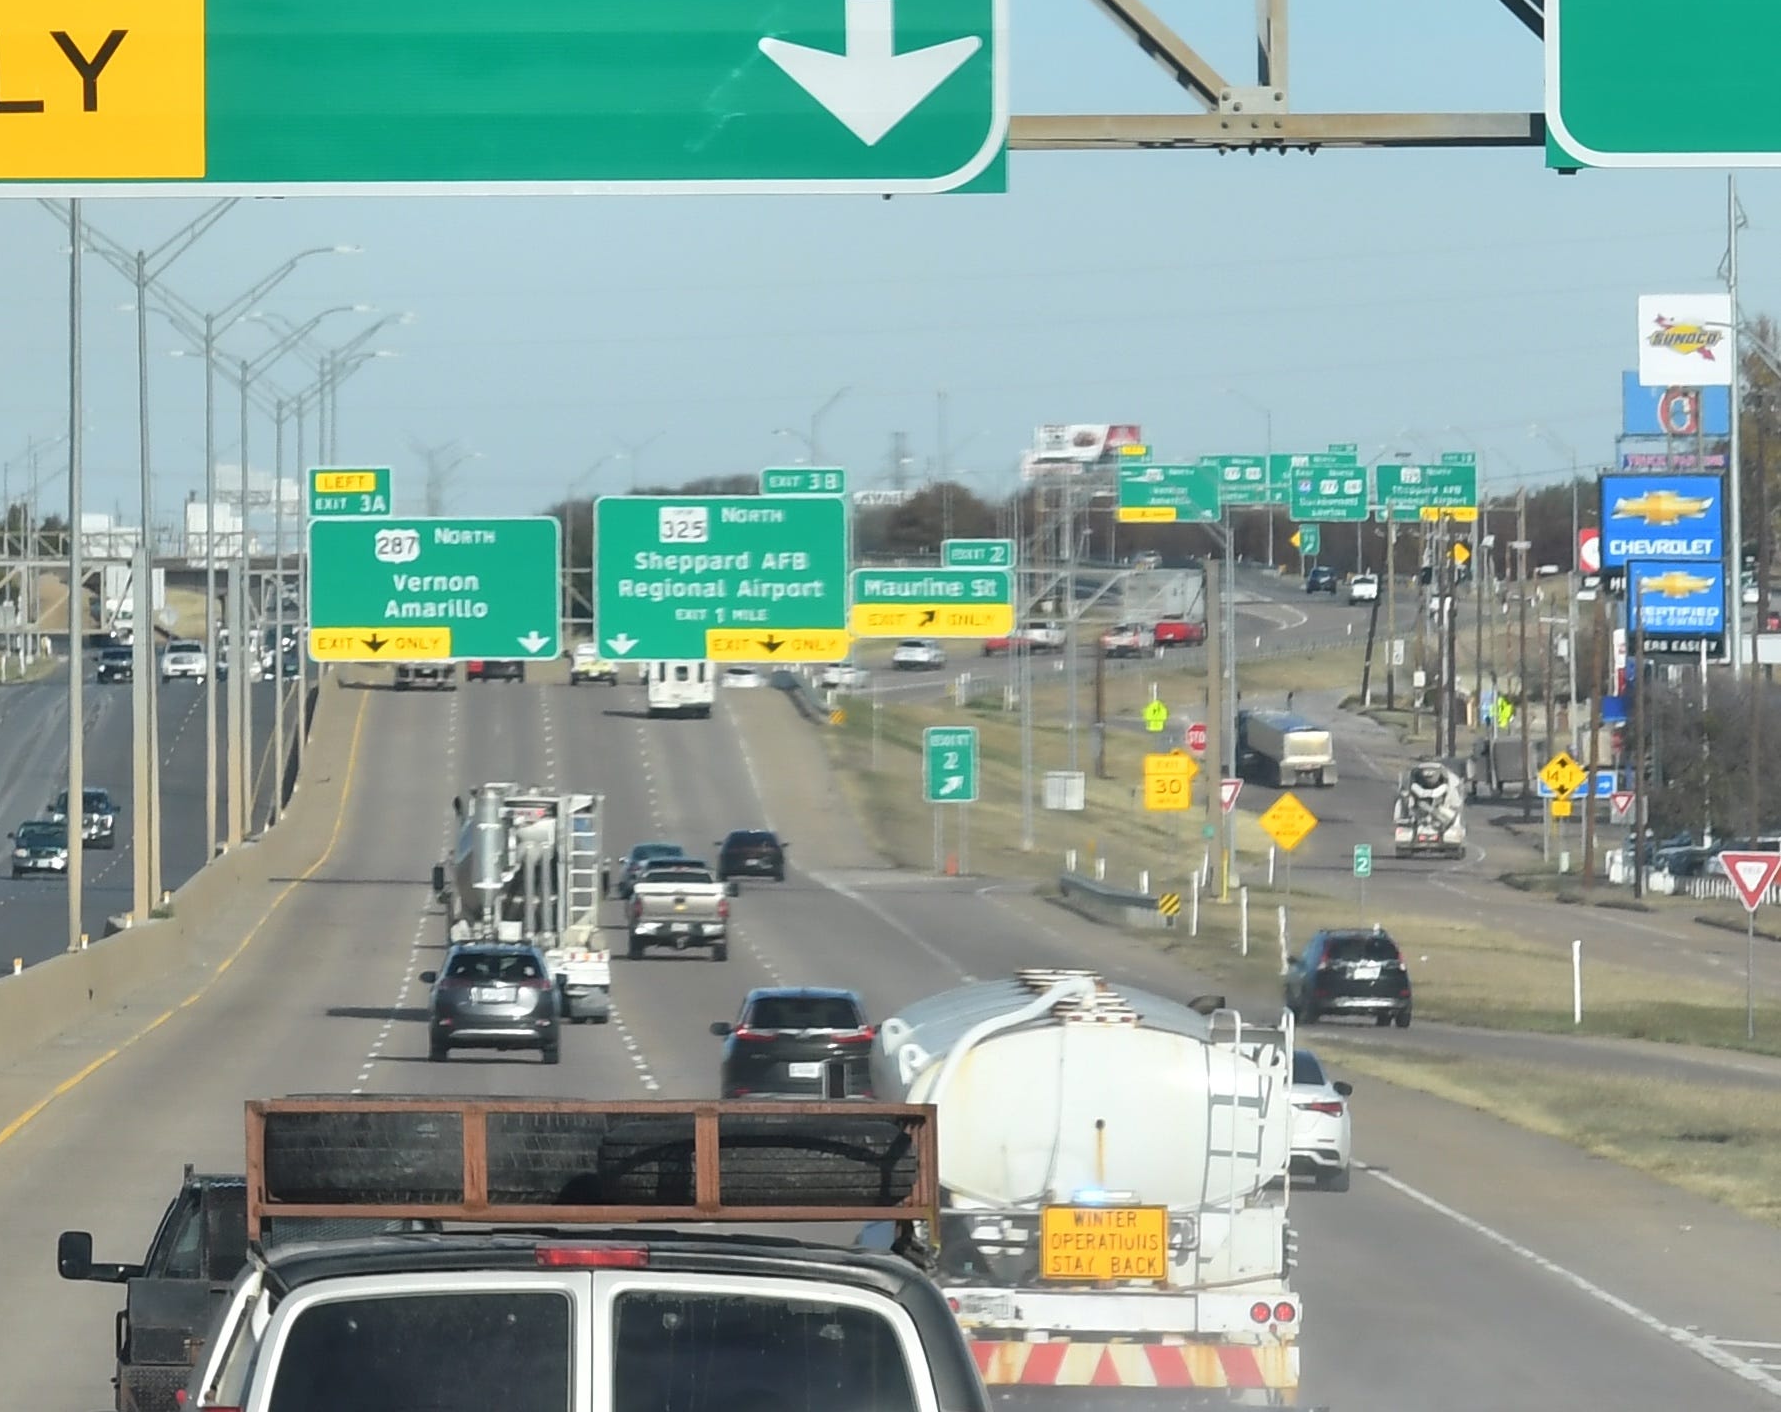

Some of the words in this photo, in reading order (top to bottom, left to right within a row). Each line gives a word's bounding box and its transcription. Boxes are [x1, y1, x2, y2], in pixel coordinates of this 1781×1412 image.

[1652, 331, 1719, 346] SUNOCO
[324, 476, 365, 490] LEFT
[769, 476, 801, 489] EXIT
[315, 497, 347, 511] EXIT
[721, 507, 785, 523] NORTH
[434, 528, 496, 545] NORTH
[662, 520, 706, 539] 325
[377, 536, 417, 556] 287
[989, 545, 1006, 564] 2
[1610, 539, 1715, 555] CHEVROLET
[634, 551, 752, 575] Sheppard
[761, 551, 810, 571] AFB
[393, 573, 480, 593] Vernon
[618, 579, 726, 603] Regional
[736, 578, 826, 602] Airport
[864, 576, 965, 598] Maurine
[385, 599, 489, 619] Amarillo
[675, 609, 708, 621] EXIT
[732, 609, 769, 621] MILE
[318, 637, 355, 650] EXIT
[395, 637, 442, 650] ONLY
[713, 638, 751, 652] EXIT
[1643, 639, 1668, 652] ERB
[943, 751, 959, 770] 2
[1155, 779, 1182, 794] 30
[1074, 1211, 1137, 1228] WINTER
[1052, 1255, 1095, 1273] STAY
[1111, 1256, 1157, 1274] BACK
